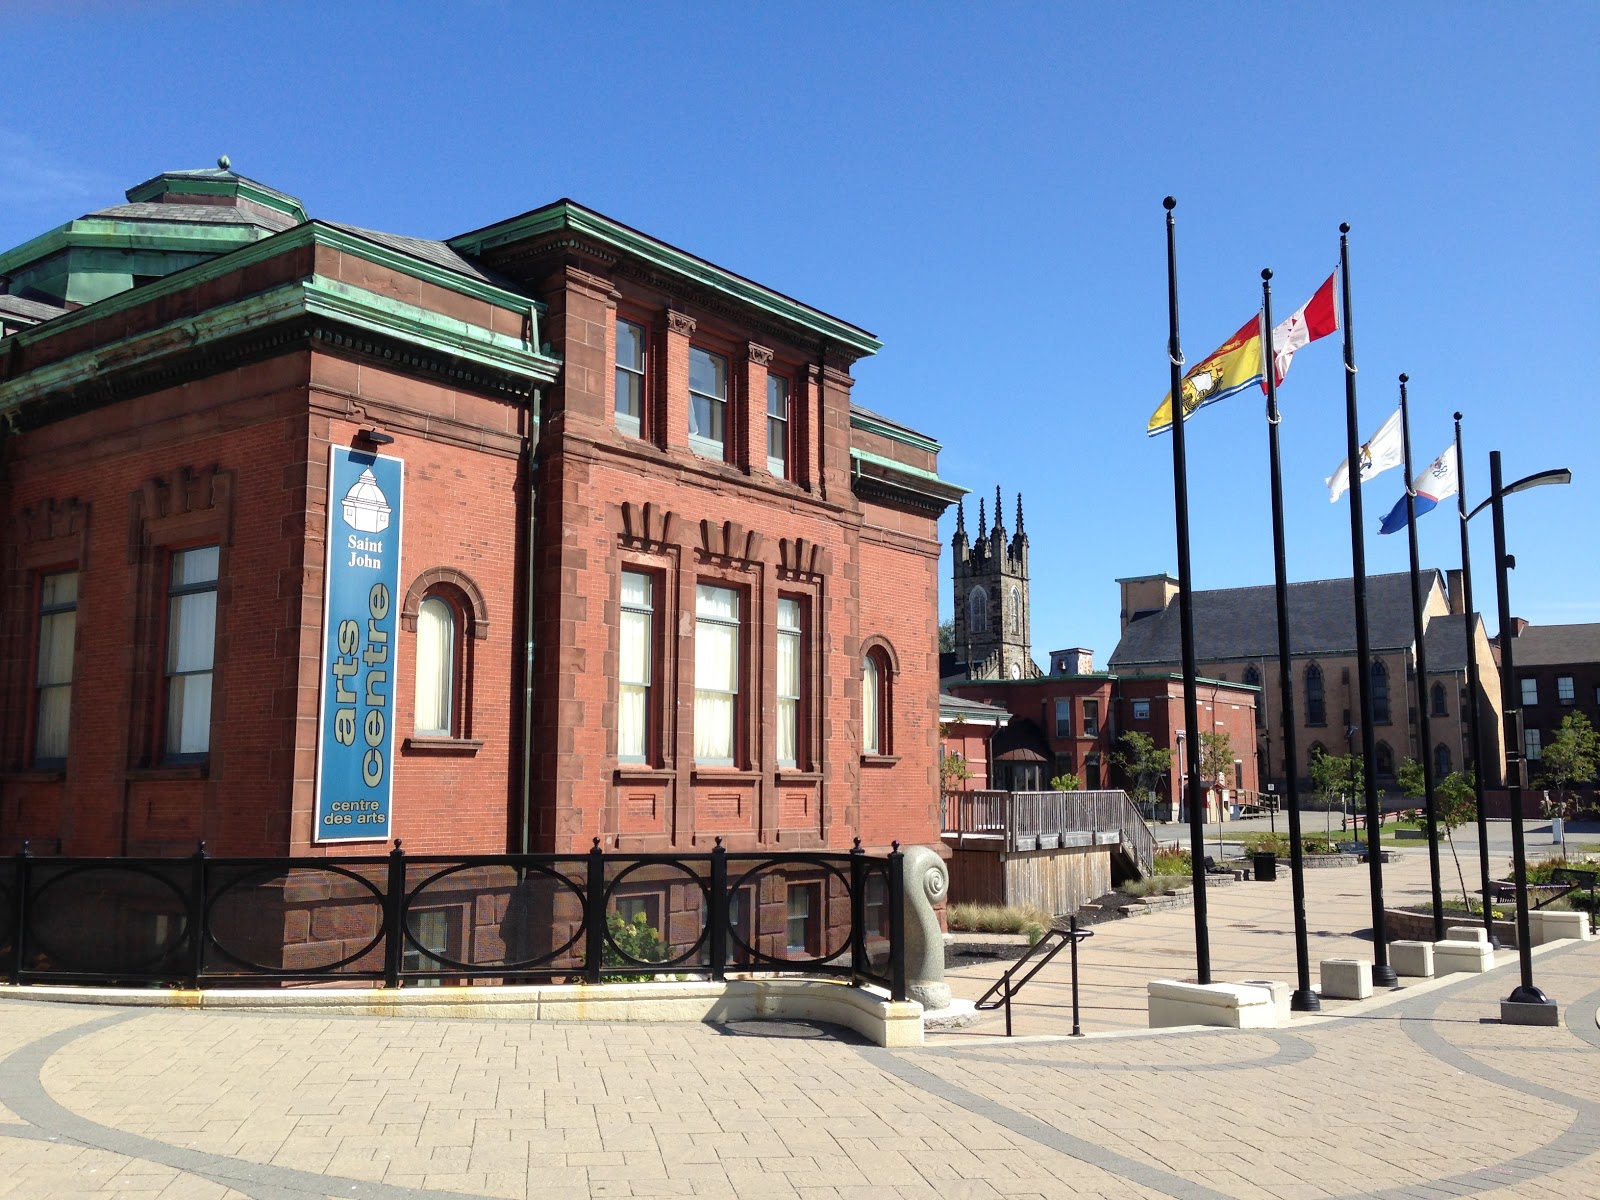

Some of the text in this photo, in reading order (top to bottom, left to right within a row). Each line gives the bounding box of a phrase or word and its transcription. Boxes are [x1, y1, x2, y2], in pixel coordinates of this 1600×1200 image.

[348, 534, 383, 553] Saint
[348, 551, 381, 570] John
[332, 619, 360, 747] arts
[362, 582, 390, 788] centre
[331, 799, 379, 811] centre
[324, 812, 386, 825] des arts
